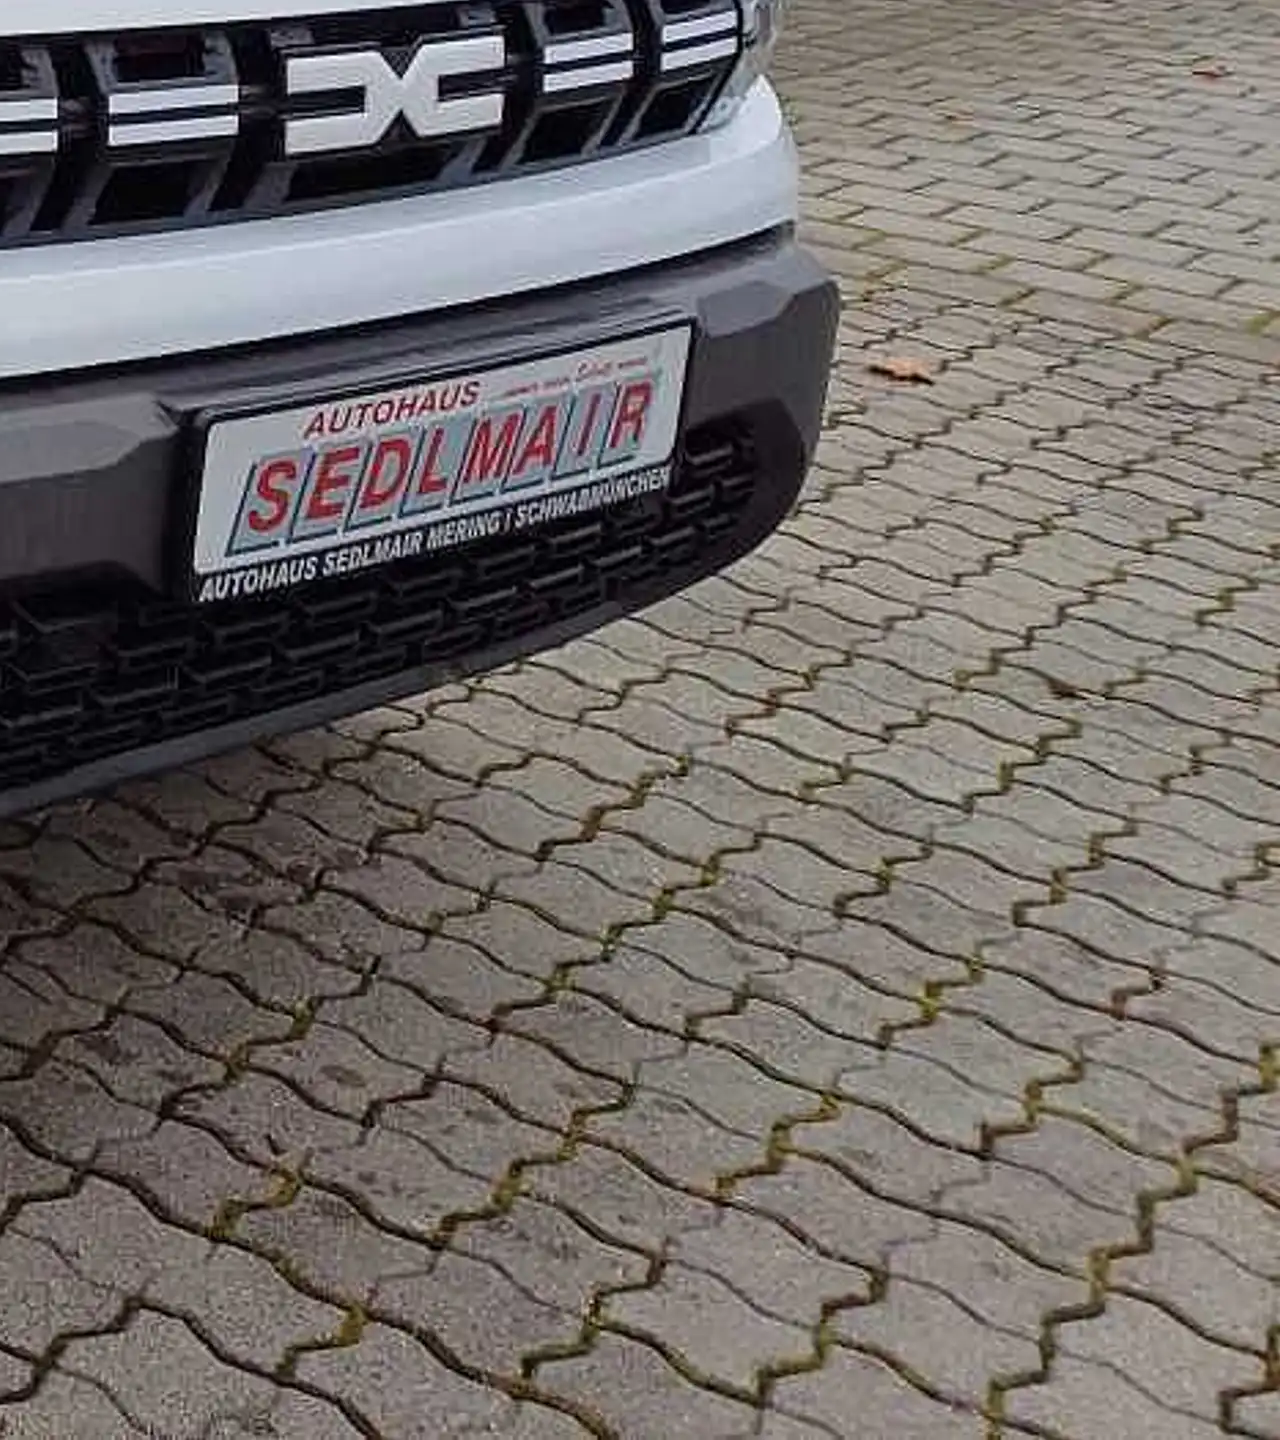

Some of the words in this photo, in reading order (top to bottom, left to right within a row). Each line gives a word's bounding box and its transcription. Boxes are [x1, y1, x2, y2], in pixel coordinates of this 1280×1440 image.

[303, 380, 480, 439] AUTOHAUS
[248, 380, 654, 534] SEDLMAIR
[199, 556, 319, 603] AUTOHAUS
[322, 530, 424, 576] SEDLMAIR
[426, 511, 500, 550] MERING
